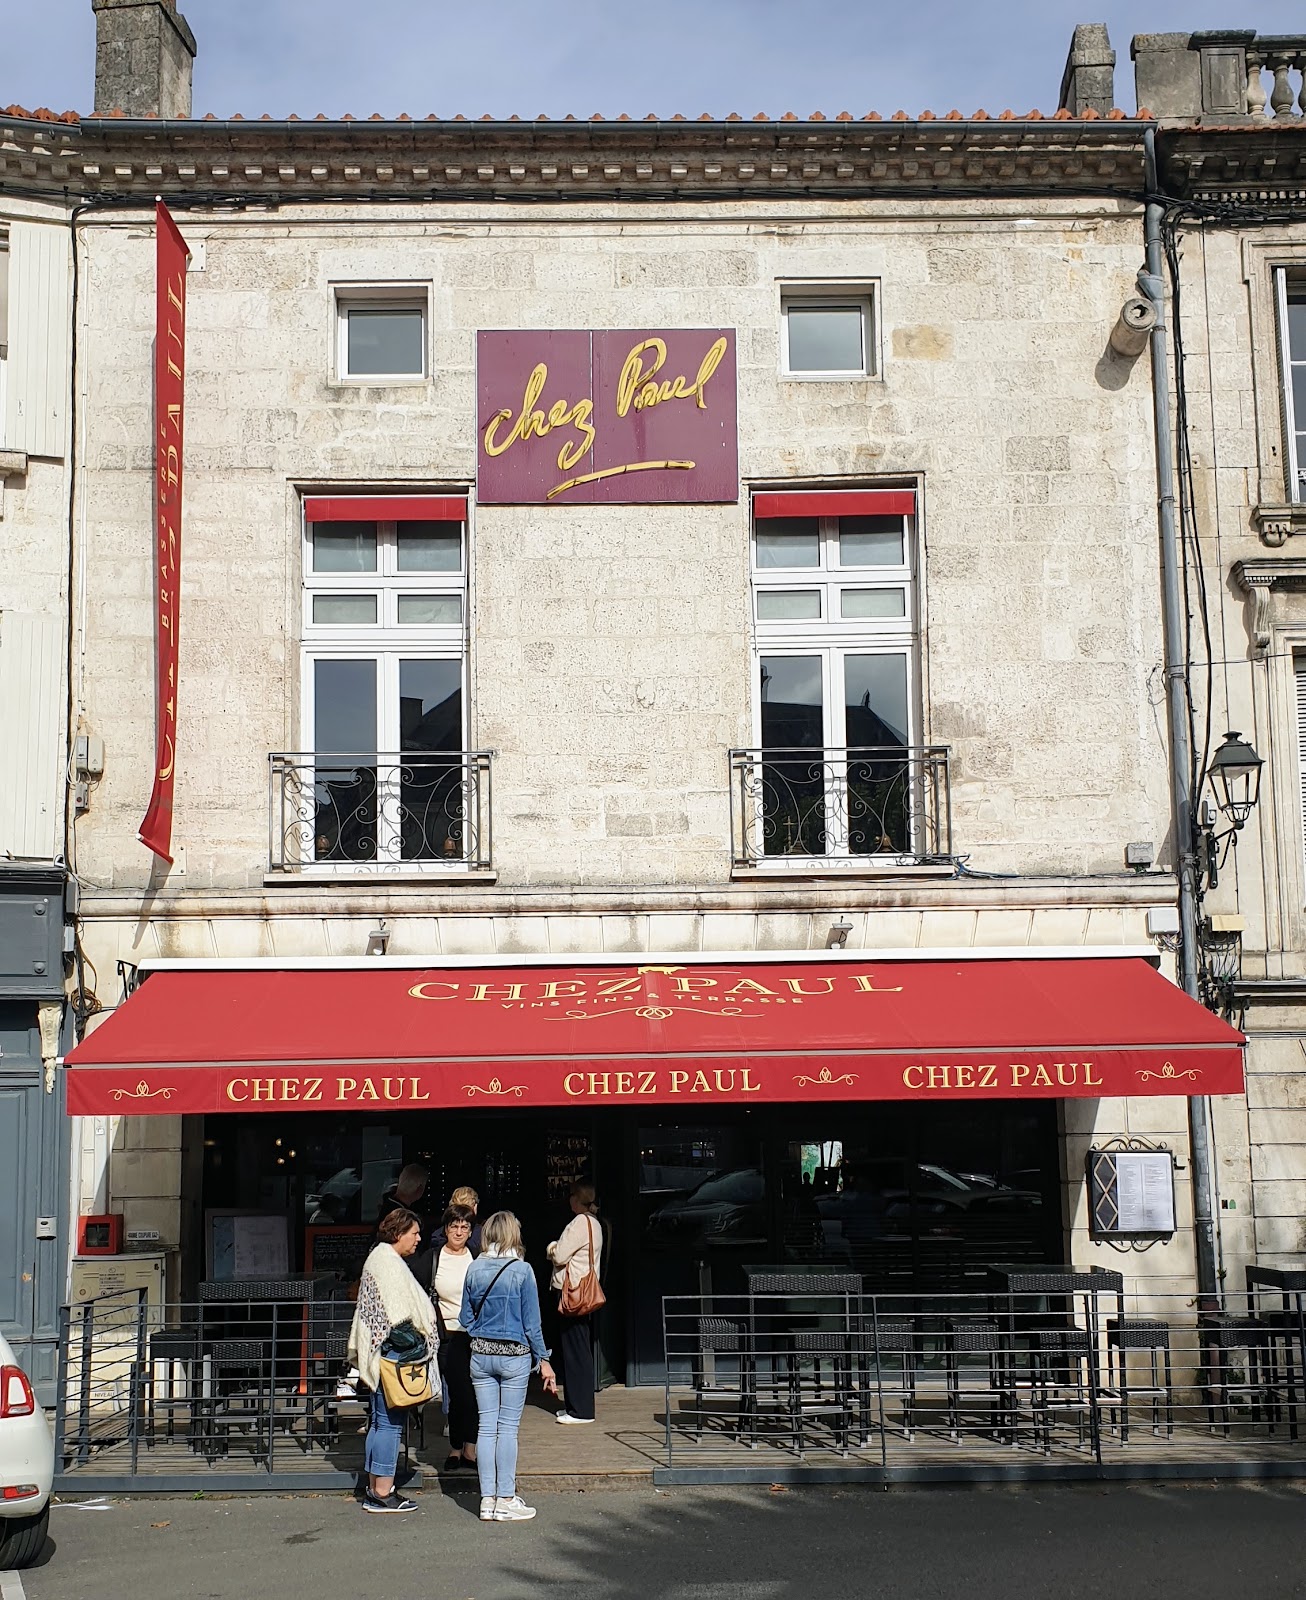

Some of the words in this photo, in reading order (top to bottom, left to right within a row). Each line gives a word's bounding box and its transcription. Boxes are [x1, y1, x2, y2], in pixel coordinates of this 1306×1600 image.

[616, 337, 727, 417] Paul
[160, 423, 170, 628] BRASSERIE
[408, 976, 642, 1001] CHEZ
[669, 975, 904, 995] PAUL
[501, 1000, 560, 1009] VINS
[577, 995, 634, 1005] FINS
[674, 994, 804, 1004] TERRASSE
[226, 1078, 323, 1101] CHEZ
[335, 1077, 430, 1100] PAUL
[563, 1071, 657, 1095] CHEZ
[669, 1068, 761, 1092] PAUL
[902, 1065, 998, 1089] CHEZ
[1009, 1063, 1103, 1086] PAUL
